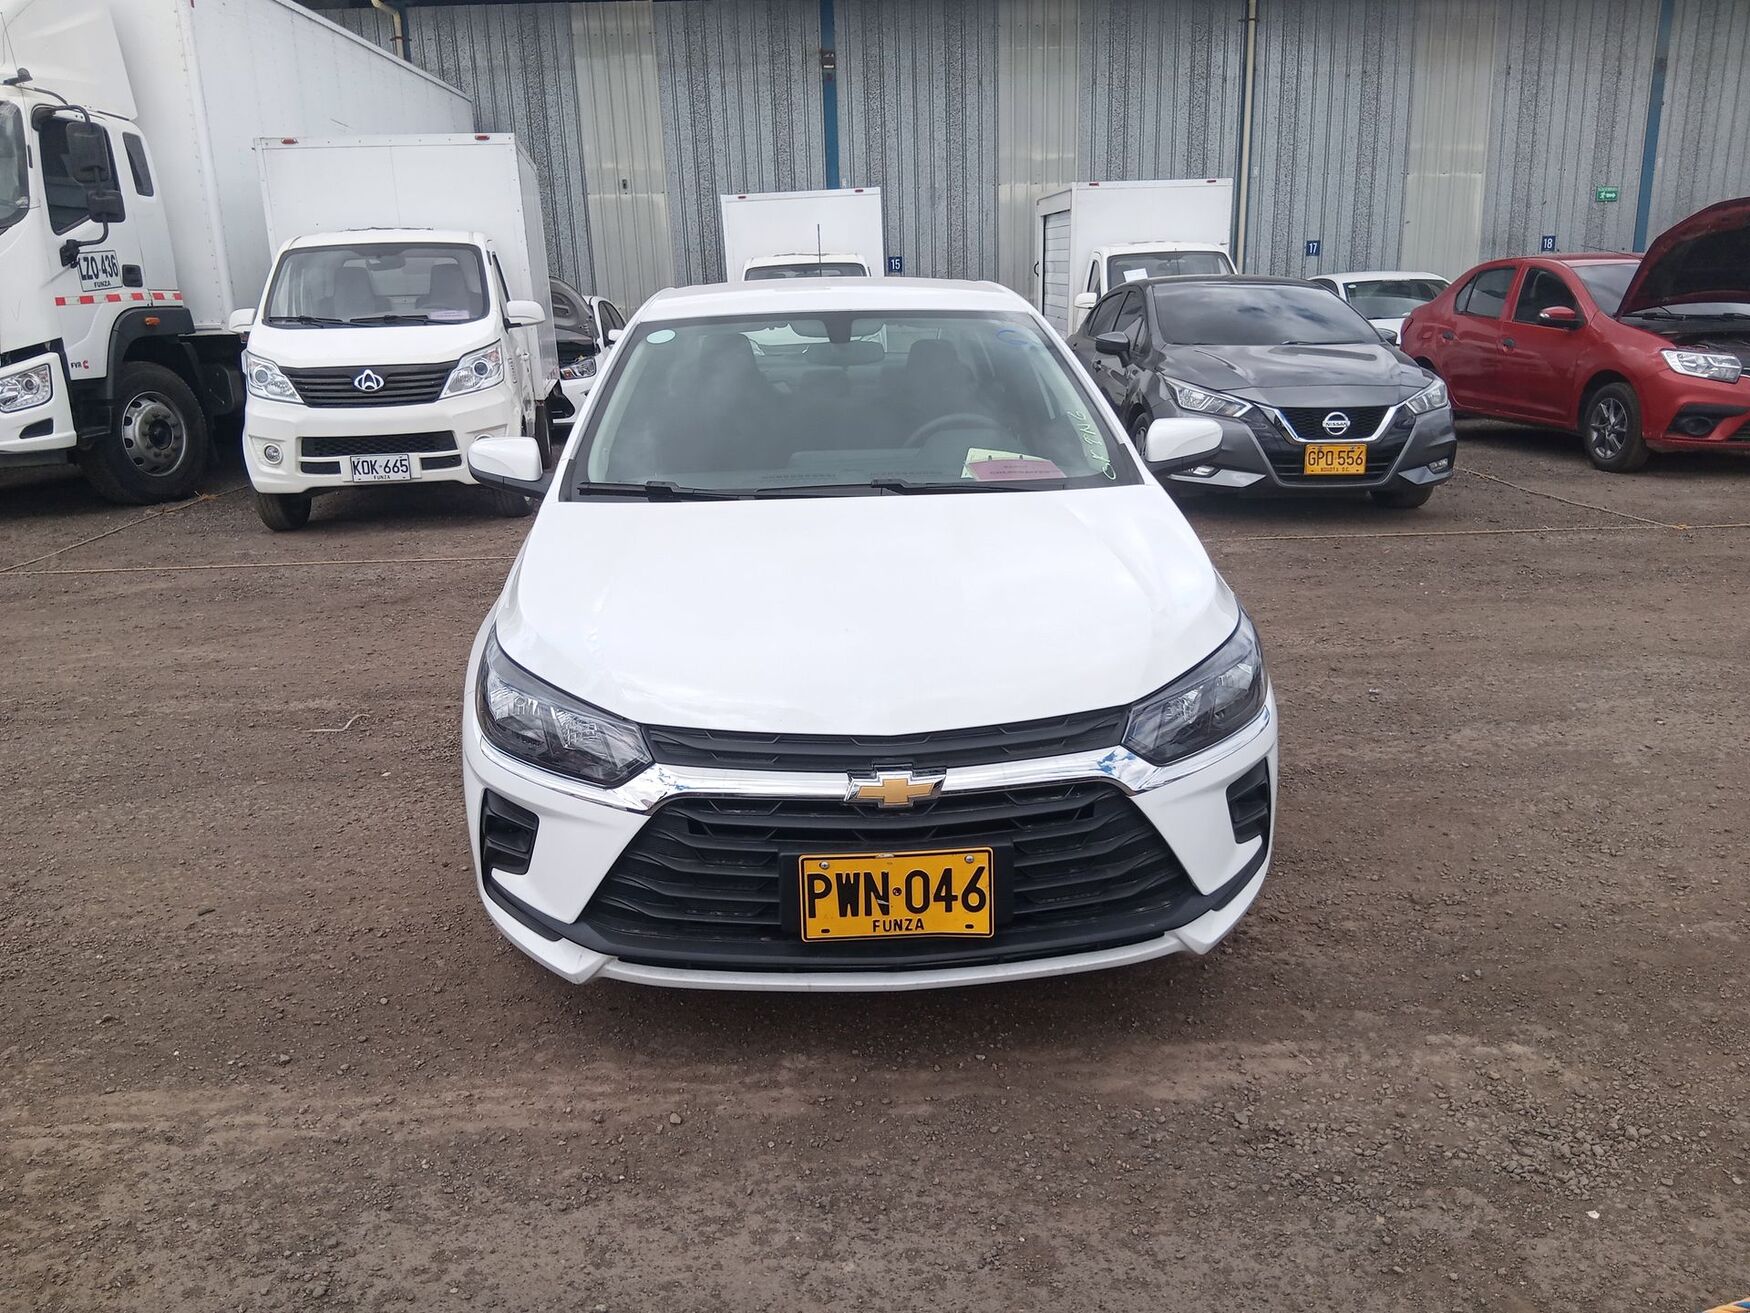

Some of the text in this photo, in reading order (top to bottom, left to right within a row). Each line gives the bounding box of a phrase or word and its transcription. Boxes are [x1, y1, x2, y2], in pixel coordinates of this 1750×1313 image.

[1309, 242, 1318, 254] 17
[1543, 238, 1553, 249] 18
[890, 258, 901, 270] 15
[93, 280, 111, 288] FUNZA
[872, 918, 925, 933] FUNZA
